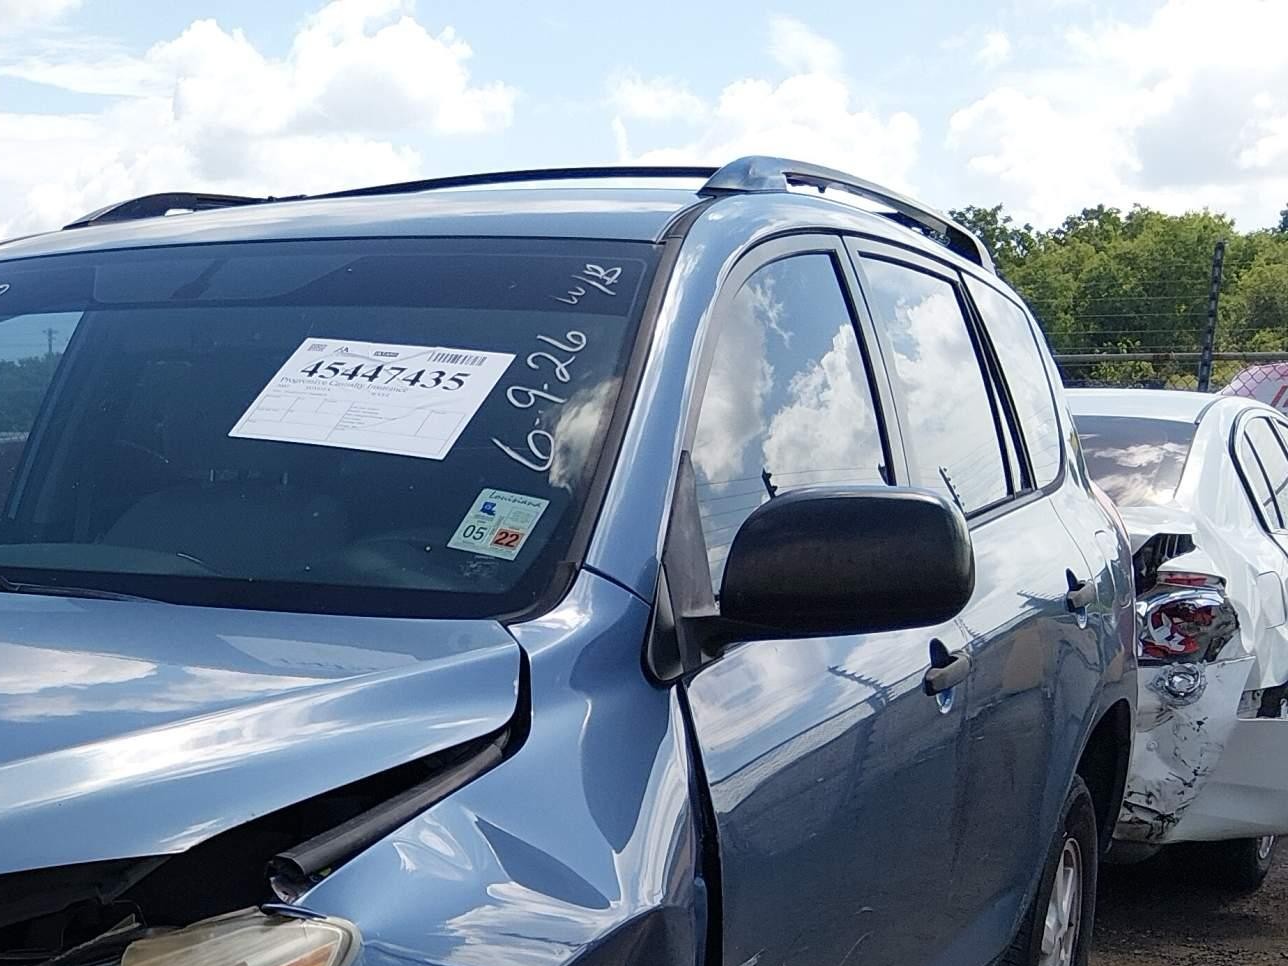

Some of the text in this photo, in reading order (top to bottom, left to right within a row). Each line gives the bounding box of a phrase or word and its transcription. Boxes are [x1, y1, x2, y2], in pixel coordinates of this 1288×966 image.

[301, 360, 472, 392] 45447435
[492, 330, 587, 471] 6-9-26
[489, 491, 541, 507] Louisiana
[463, 525, 519, 547] 05 22
